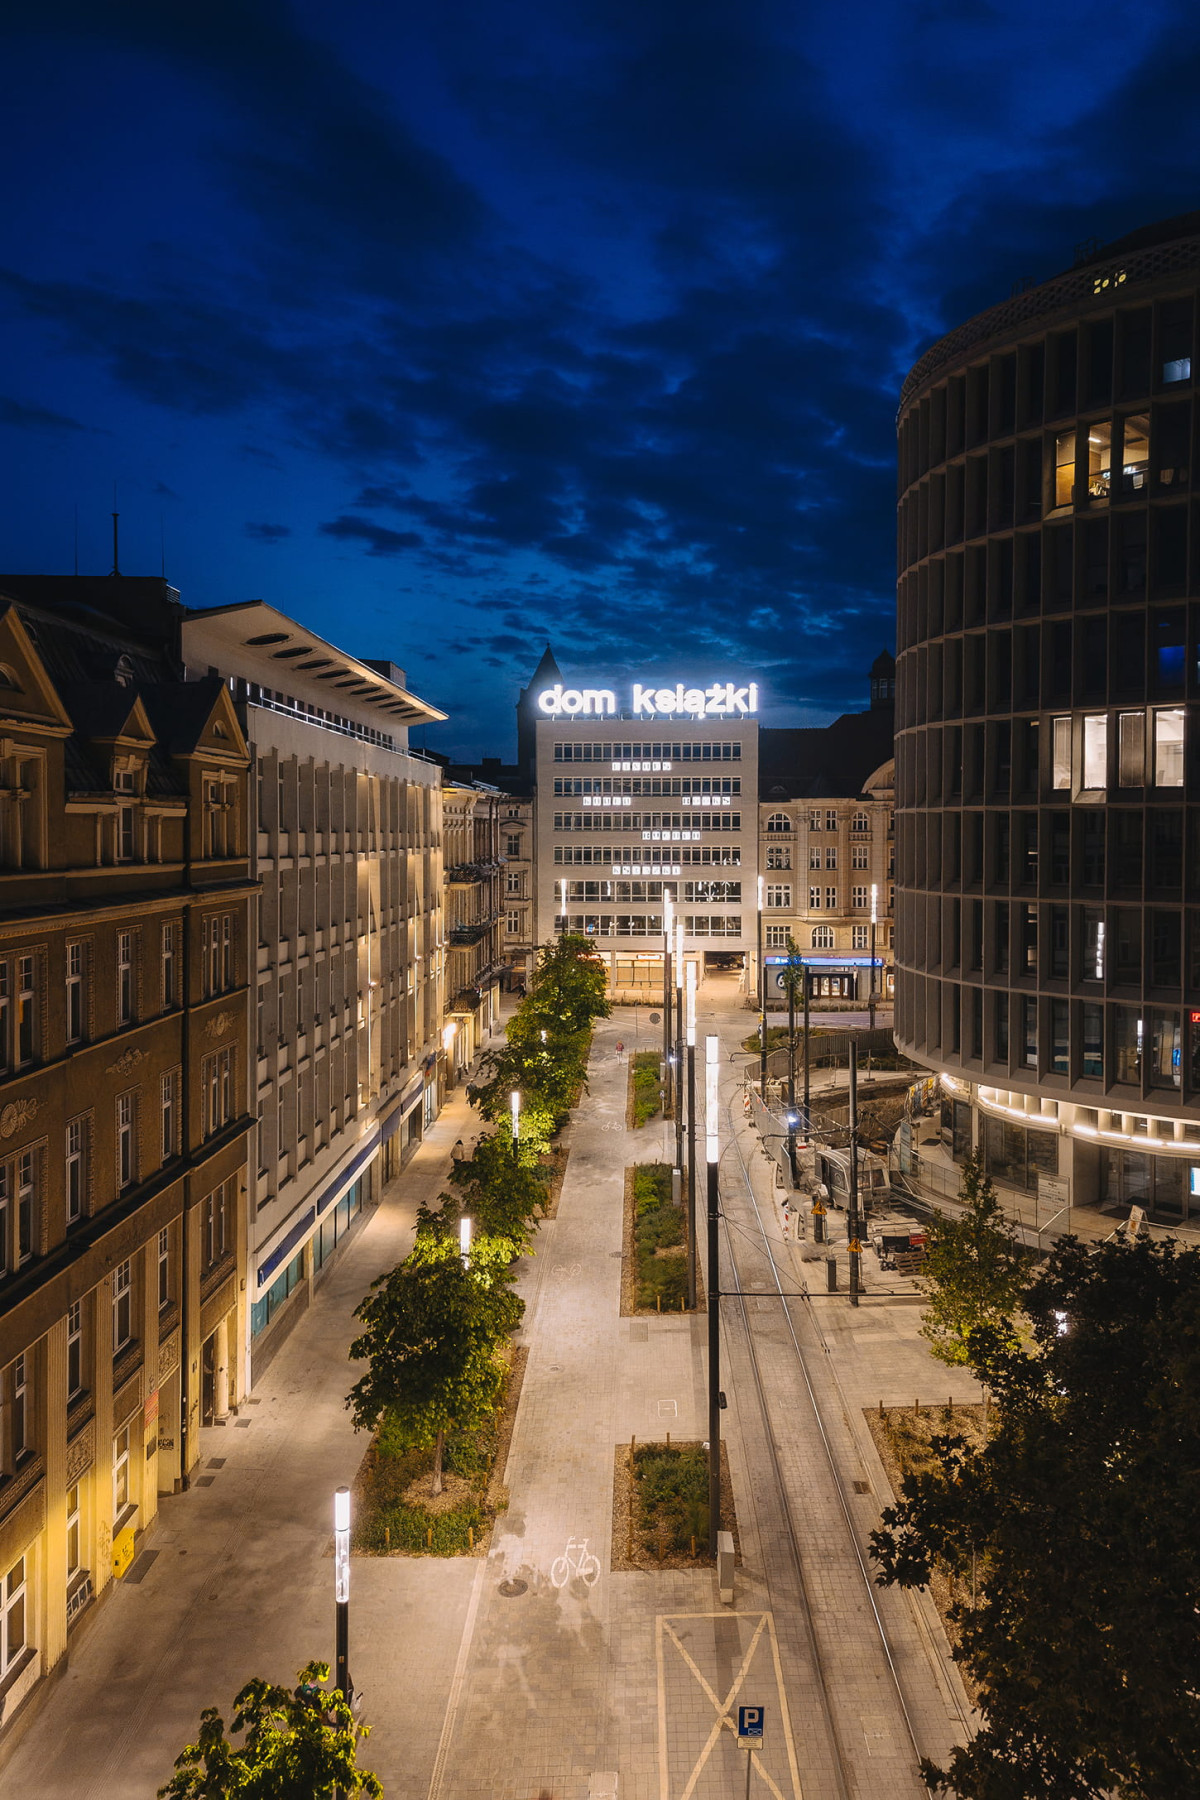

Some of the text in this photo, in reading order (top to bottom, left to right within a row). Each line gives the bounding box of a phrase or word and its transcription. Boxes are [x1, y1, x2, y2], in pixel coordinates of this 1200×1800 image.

[538, 683, 759, 719] dom książki
[744, 1708, 759, 1728] P
